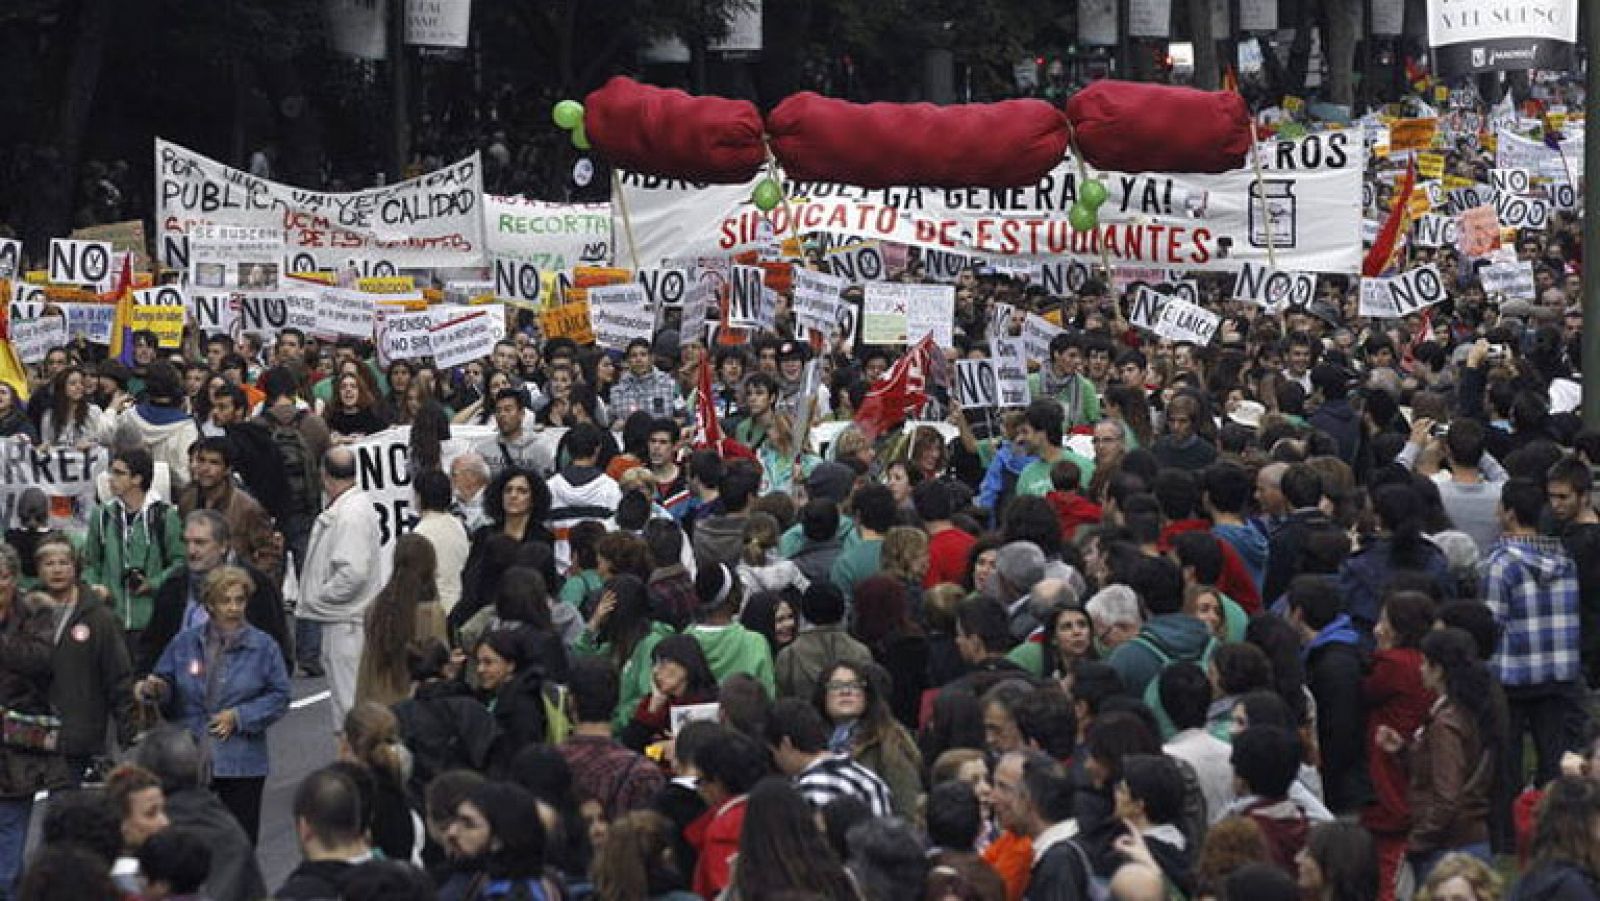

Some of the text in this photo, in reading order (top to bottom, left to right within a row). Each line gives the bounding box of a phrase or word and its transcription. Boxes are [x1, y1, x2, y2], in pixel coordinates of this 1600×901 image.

[945, 173, 1078, 211] GENERA
[1120, 177, 1173, 214] YA!
[1491, 171, 1527, 191] NO
[381, 189, 475, 224] CALIDAD
[916, 219, 957, 247] DE
[52, 241, 109, 282] NO
[832, 248, 881, 283] NO
[1042, 259, 1088, 294] NO
[495, 259, 539, 300] NO
[639, 270, 684, 303] NO
[1388, 267, 1441, 313] NO
[241, 298, 287, 330] NO
[957, 362, 995, 405] NO
